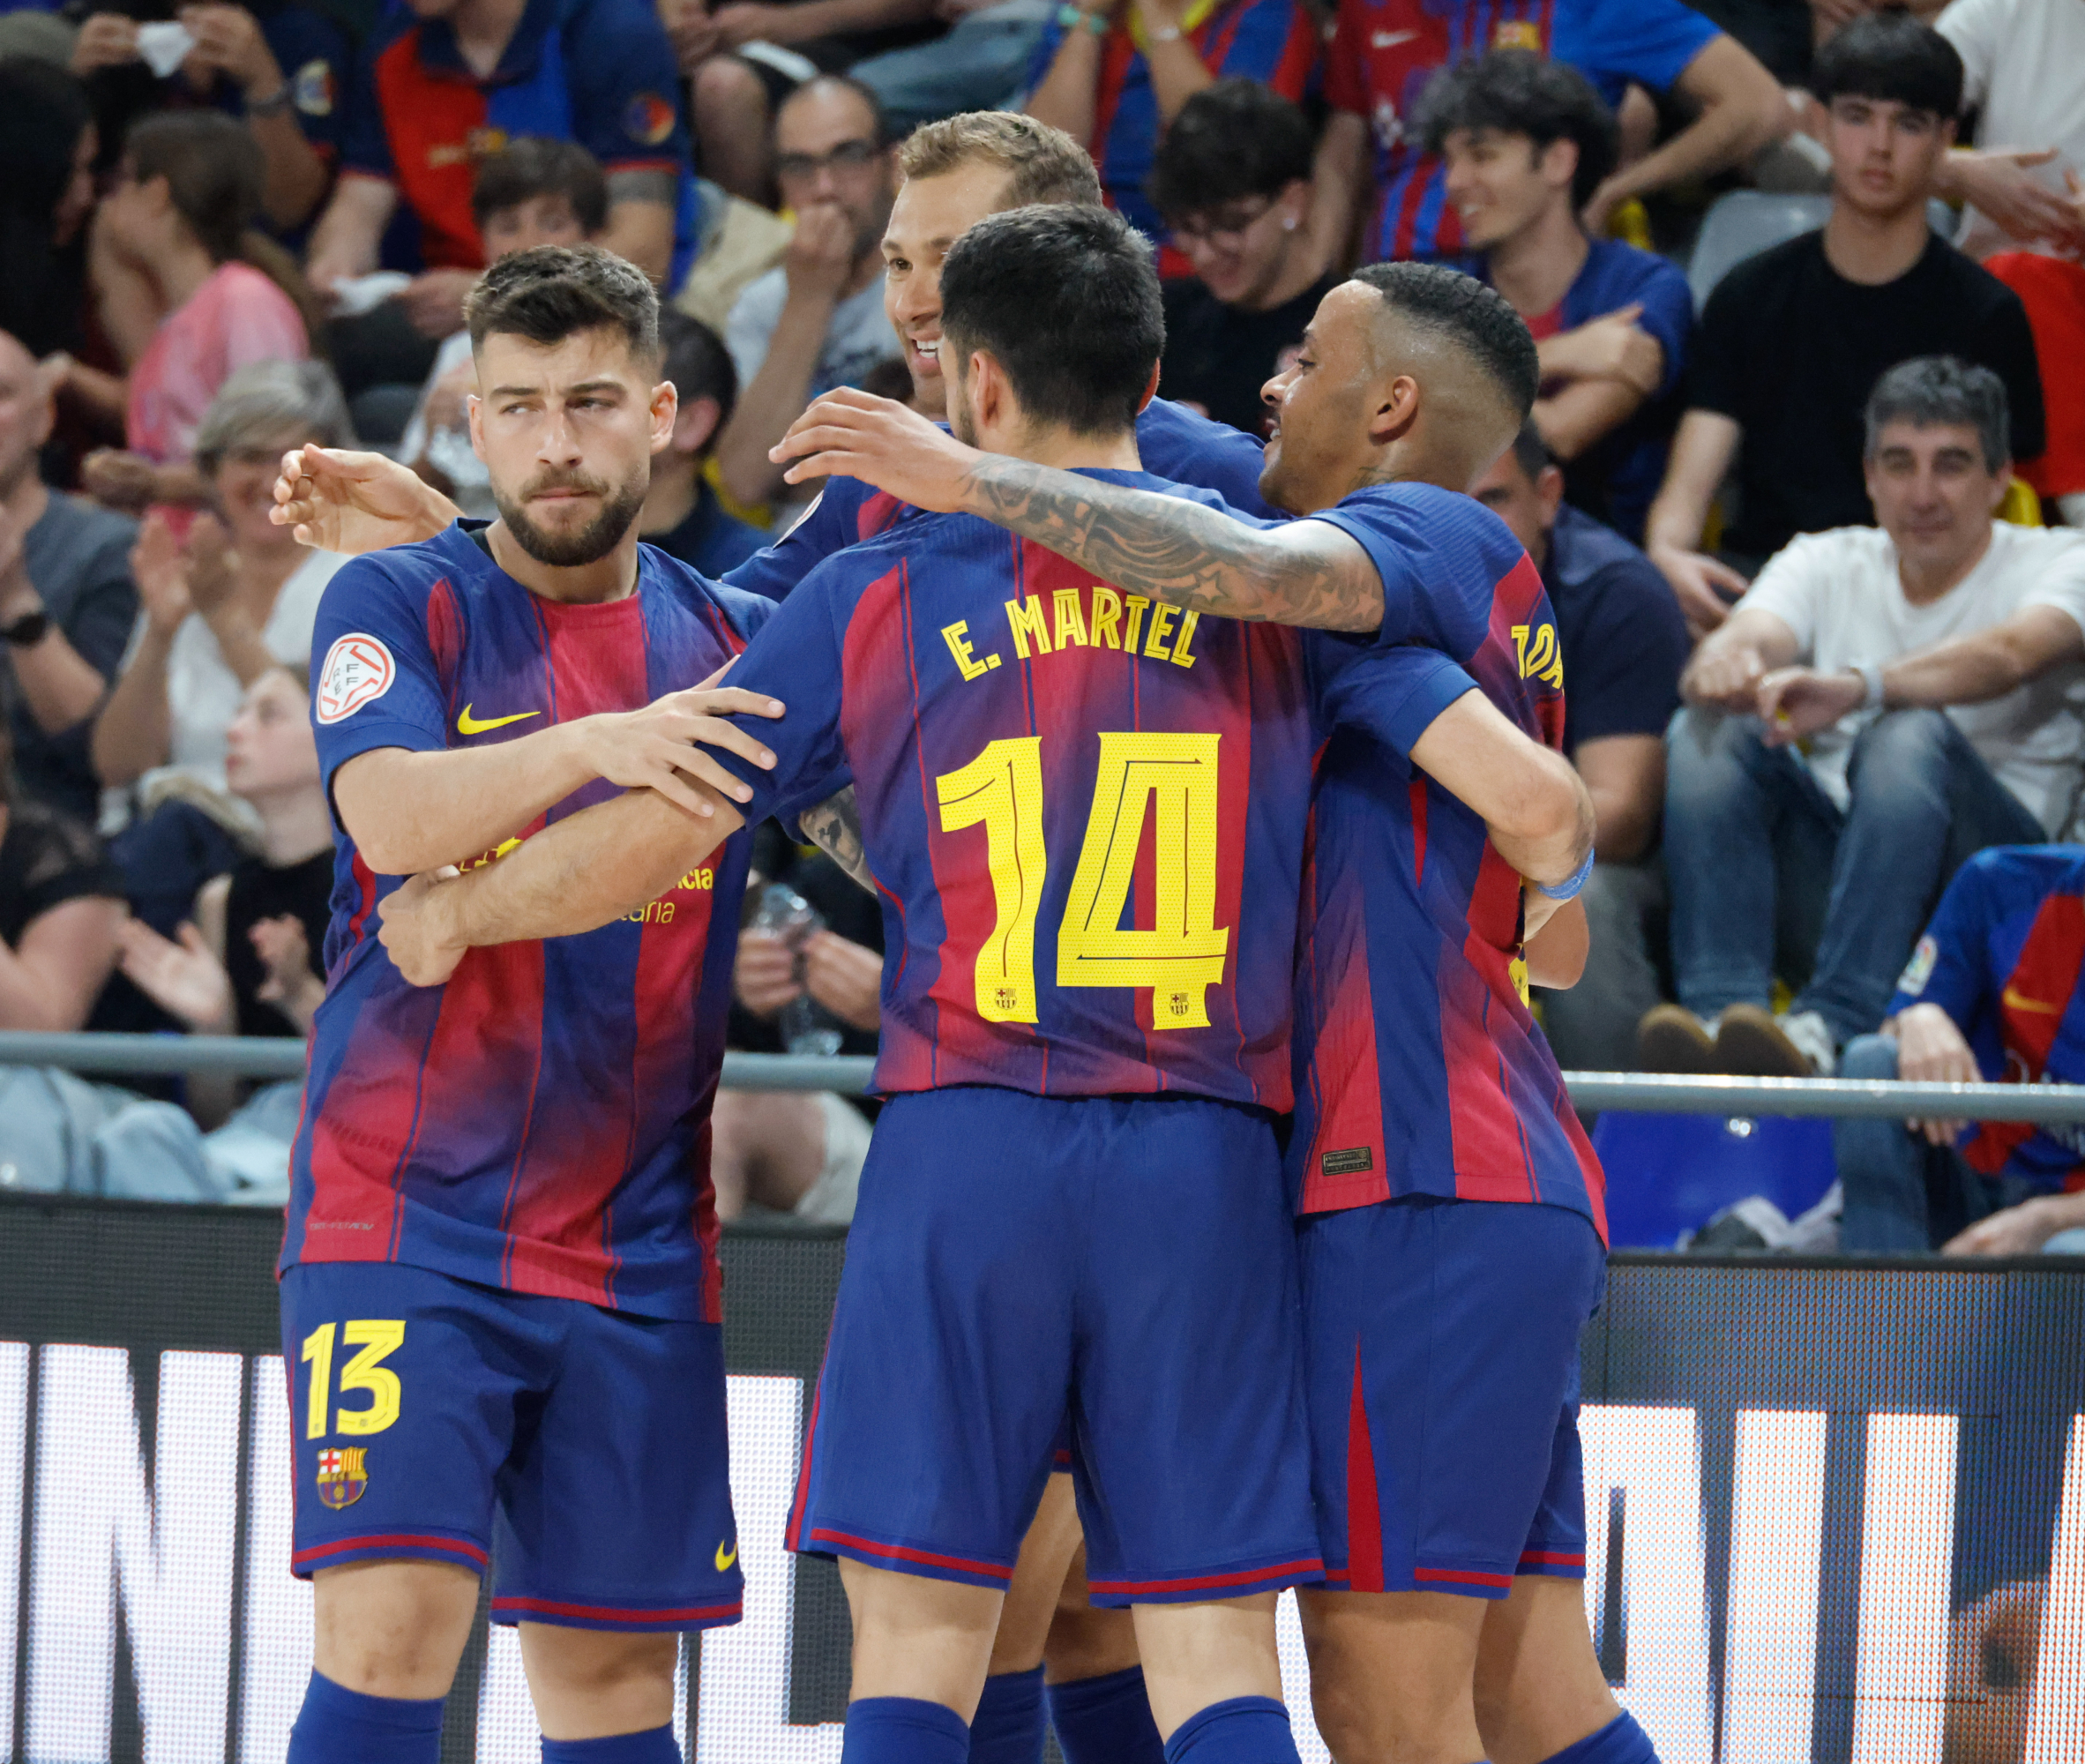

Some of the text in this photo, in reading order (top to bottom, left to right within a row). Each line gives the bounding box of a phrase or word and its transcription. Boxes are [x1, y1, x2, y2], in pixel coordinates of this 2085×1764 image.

[941, 586, 1200, 682] E. MARTEL
[936, 732, 1230, 1031] 14
[301, 1319, 407, 1441] 13
